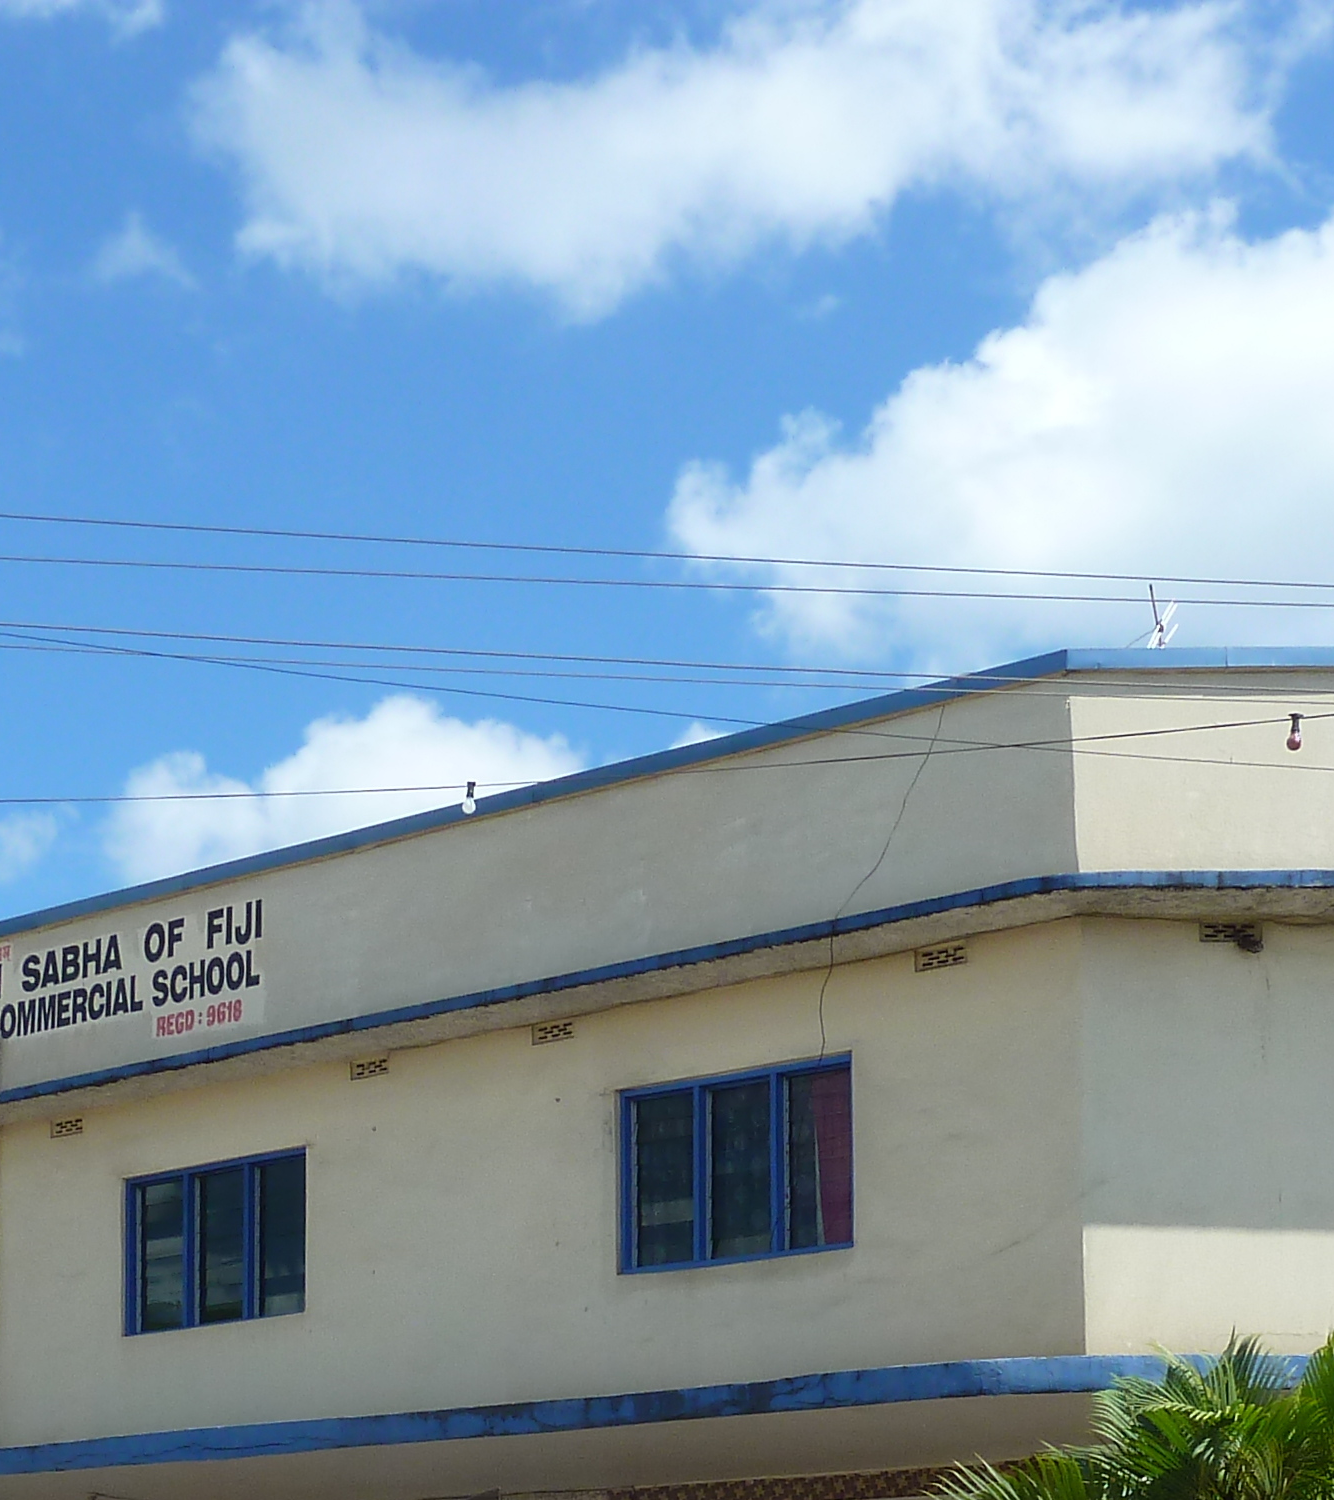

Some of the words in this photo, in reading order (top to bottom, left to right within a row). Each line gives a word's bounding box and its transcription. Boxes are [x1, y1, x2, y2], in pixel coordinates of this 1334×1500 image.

[22, 934, 122, 993] SABHA
[144, 917, 185, 963] OF
[207, 899, 263, 949] FIJI
[152, 949, 261, 1007] SCHOOL
[206, 999, 243, 1027] 9618
